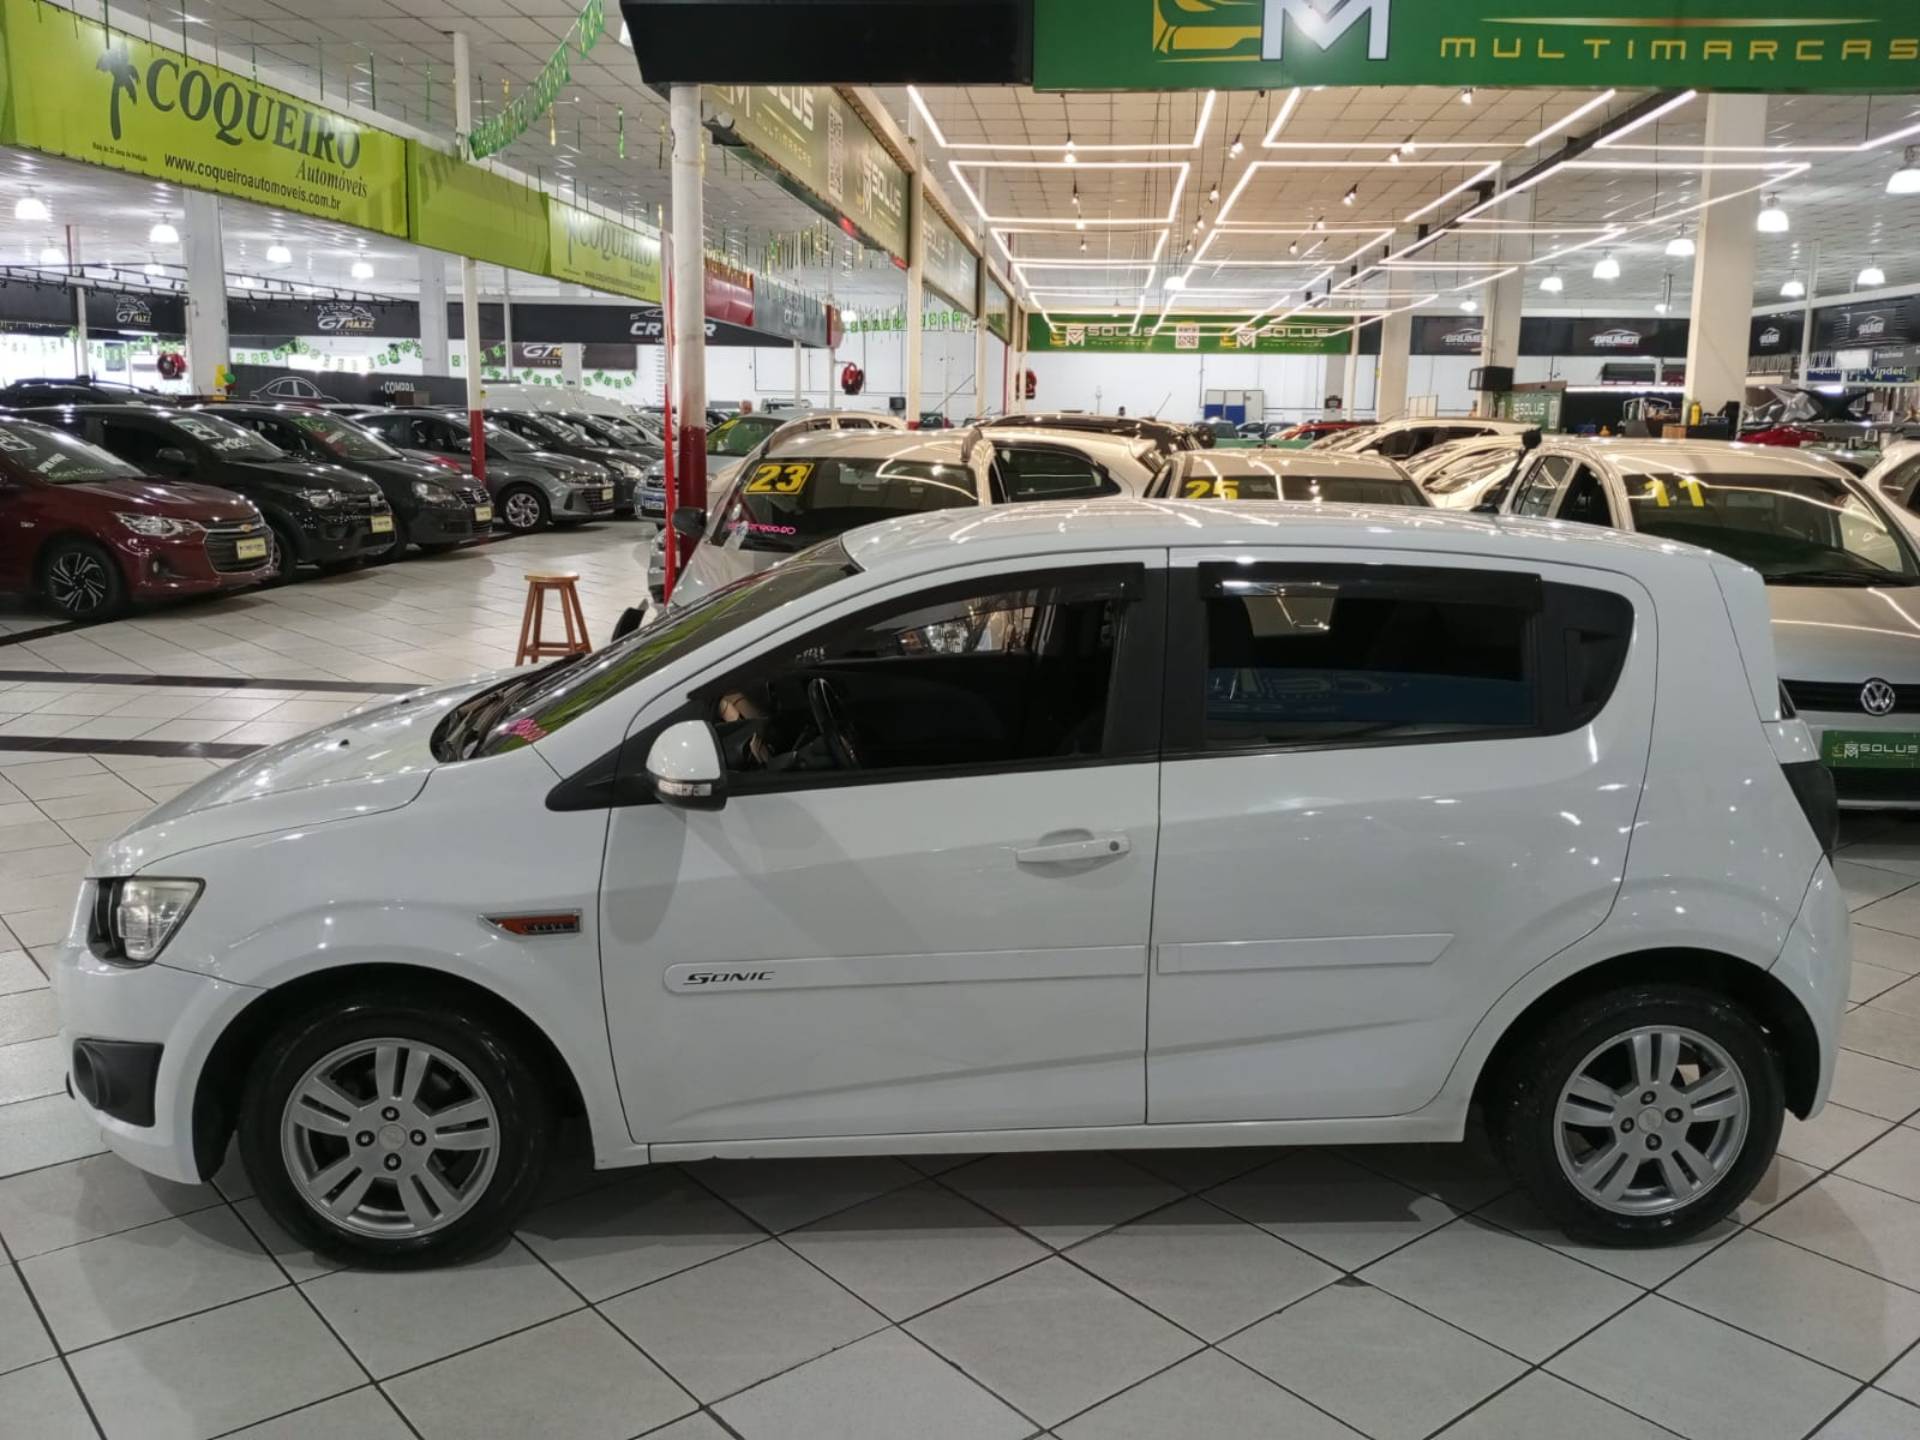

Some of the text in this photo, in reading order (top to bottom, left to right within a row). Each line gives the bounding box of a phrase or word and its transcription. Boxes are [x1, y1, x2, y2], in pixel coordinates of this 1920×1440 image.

[1440, 37, 1919, 61] MULTIMARCAS
[146, 58, 361, 169] COQUEIRO
[164, 153, 341, 211] www.coqueiroautomoveis.com.br
[296, 159, 368, 199] Automóveis
[748, 465, 808, 492] 23
[1186, 480, 1239, 502] 25
[1645, 480, 1704, 507] 11
[1860, 743, 1918, 754] SOLUS
[682, 971, 776, 986] SONIC
